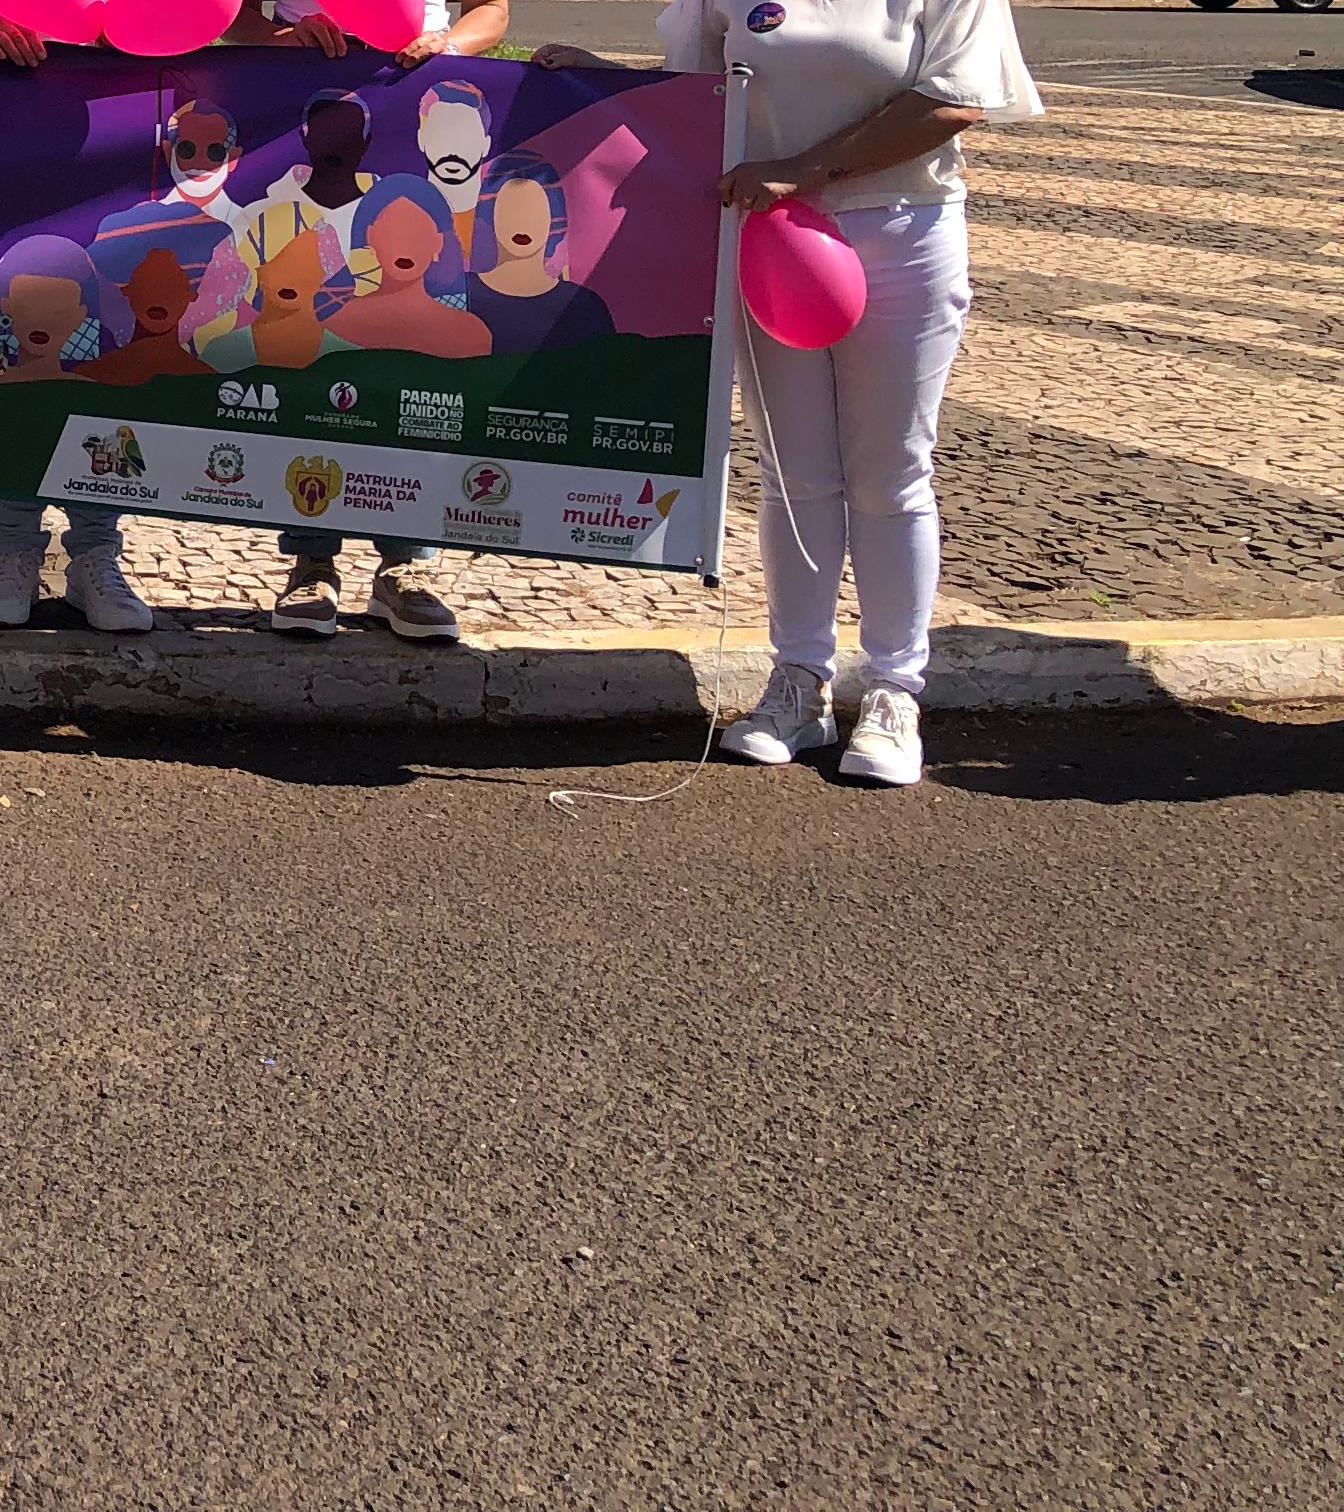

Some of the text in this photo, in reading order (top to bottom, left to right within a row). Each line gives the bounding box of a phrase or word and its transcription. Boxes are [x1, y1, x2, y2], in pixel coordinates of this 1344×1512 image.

[400, 388, 464, 408] PARANÁ
[216, 406, 279, 424] PARANÁ
[399, 403, 449, 419] UNIDO
[342, 417, 378, 428] SEGURA
[487, 414, 569, 433] SEGURANÇA
[485, 425, 569, 445] PR.GOV.BR
[591, 436, 674, 455] PR.GOV.BR
[63, 477, 118, 495] Jandaia
[119, 484, 137, 497] do
[138, 486, 160, 499] Sul
[345, 471, 423, 491] PATRULHA
[181, 491, 264, 510] Jandaia do Sul
[344, 484, 417, 502] MARIA DA
[566, 491, 623, 506] comitê
[343, 496, 395, 512] PENHA
[444, 506, 521, 529] Mulheres
[562, 507, 653, 530] mulher
[587, 531, 634, 546] Sicredi
